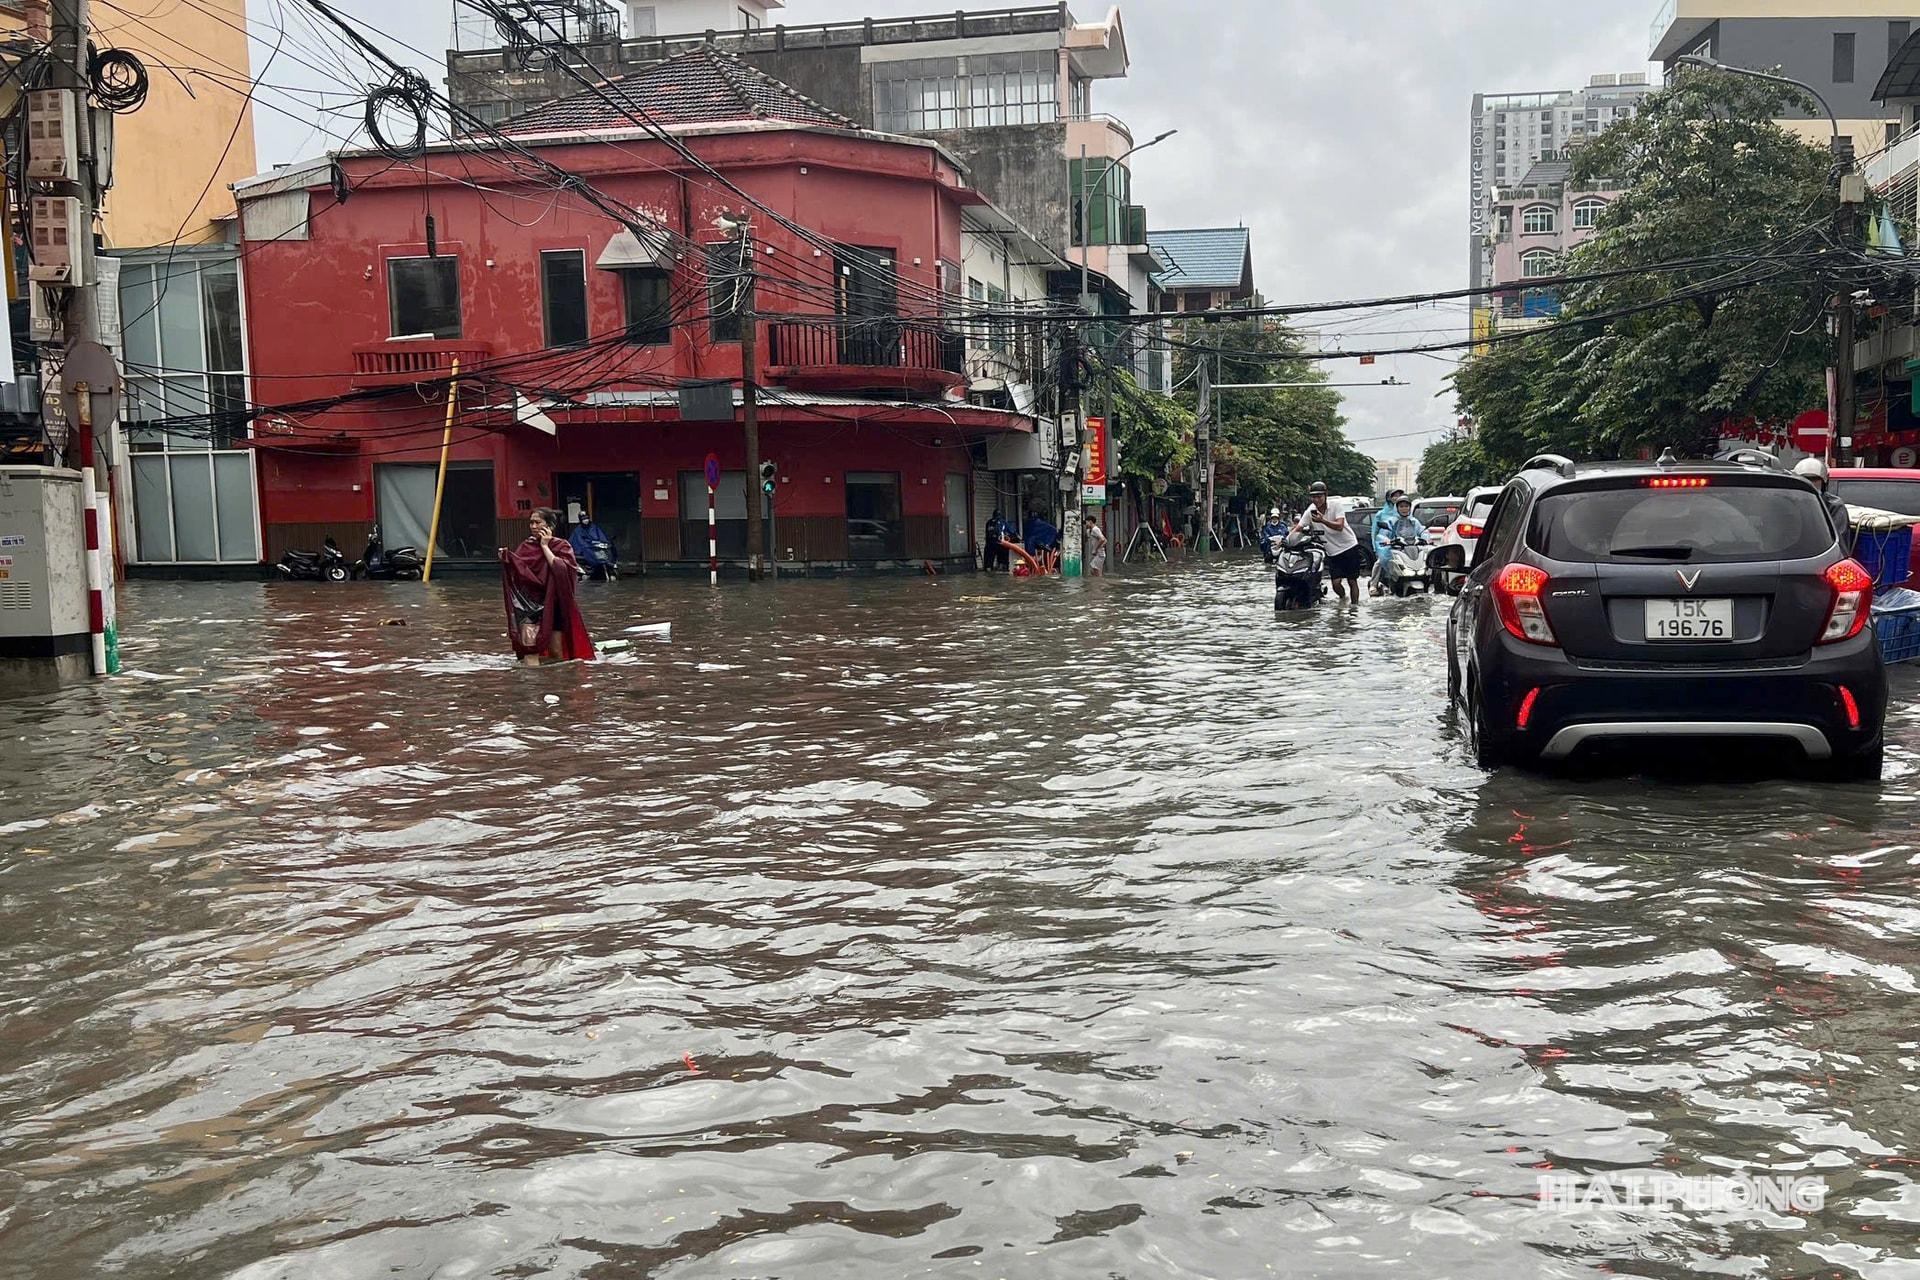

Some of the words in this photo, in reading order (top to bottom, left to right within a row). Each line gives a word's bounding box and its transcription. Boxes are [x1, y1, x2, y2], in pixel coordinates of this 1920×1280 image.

[1473, 112, 1484, 156] HOTEL
[1471, 160, 1483, 236] Mercure
[1672, 599, 1708, 617] 15K
[1658, 619, 1724, 637] 196.76
